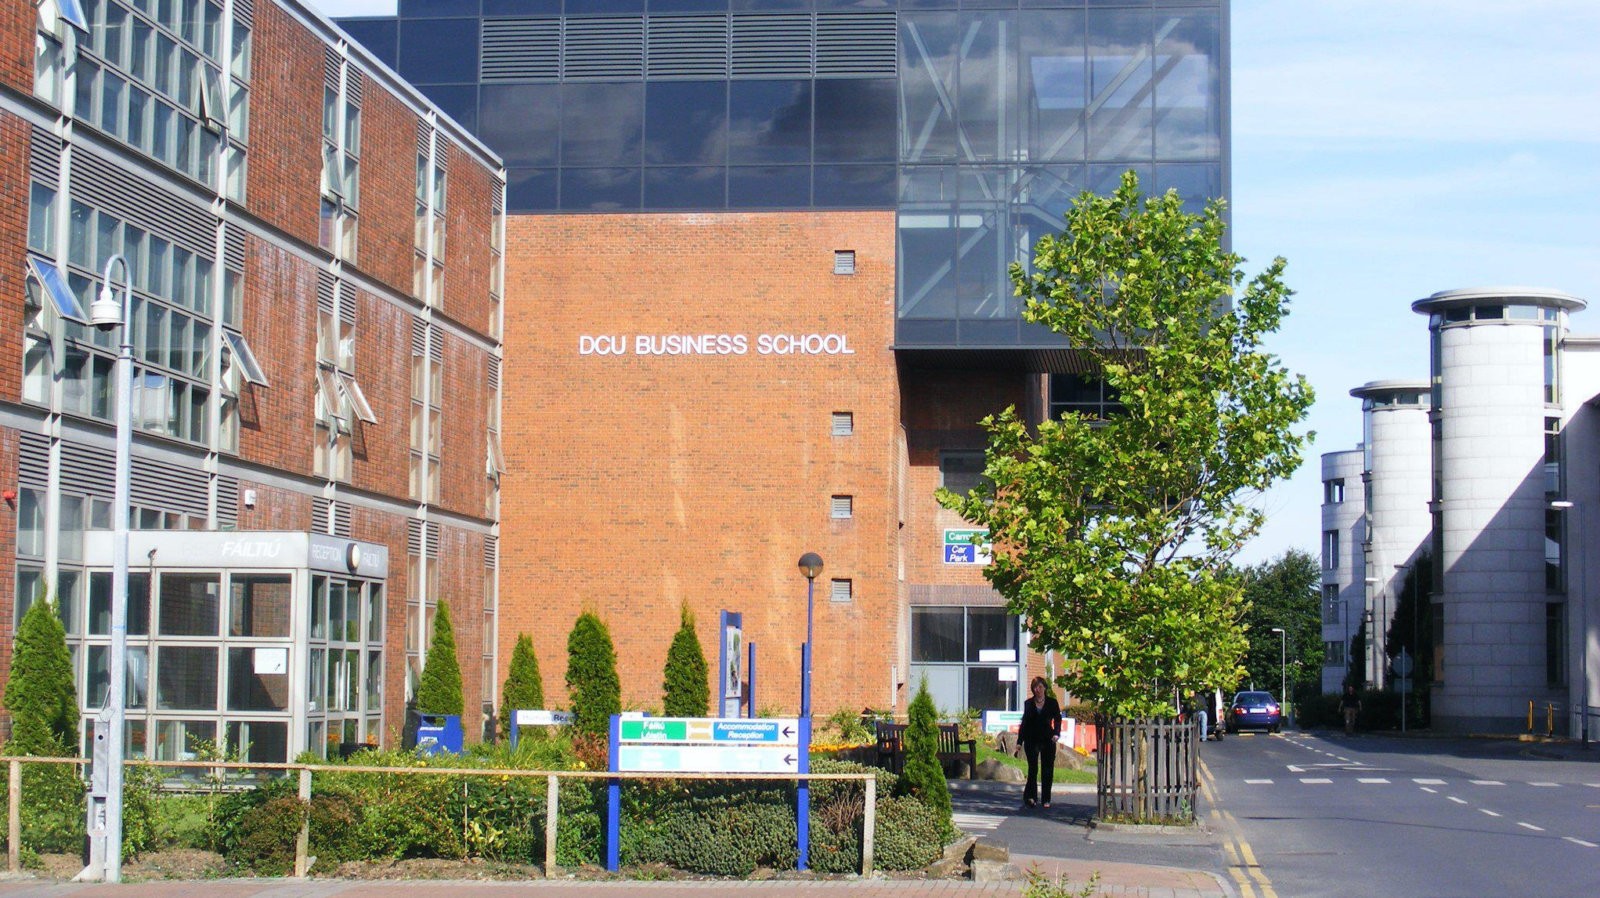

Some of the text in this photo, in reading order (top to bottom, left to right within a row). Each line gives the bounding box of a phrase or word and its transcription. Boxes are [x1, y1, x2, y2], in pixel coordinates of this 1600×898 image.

[579, 334, 855, 356] DCU BUSINESS SCHOOL
[951, 545, 966, 554] Car
[949, 554, 968, 562] Park
[717, 722, 775, 731] Accommodation
[727, 730, 765, 740] Reception
